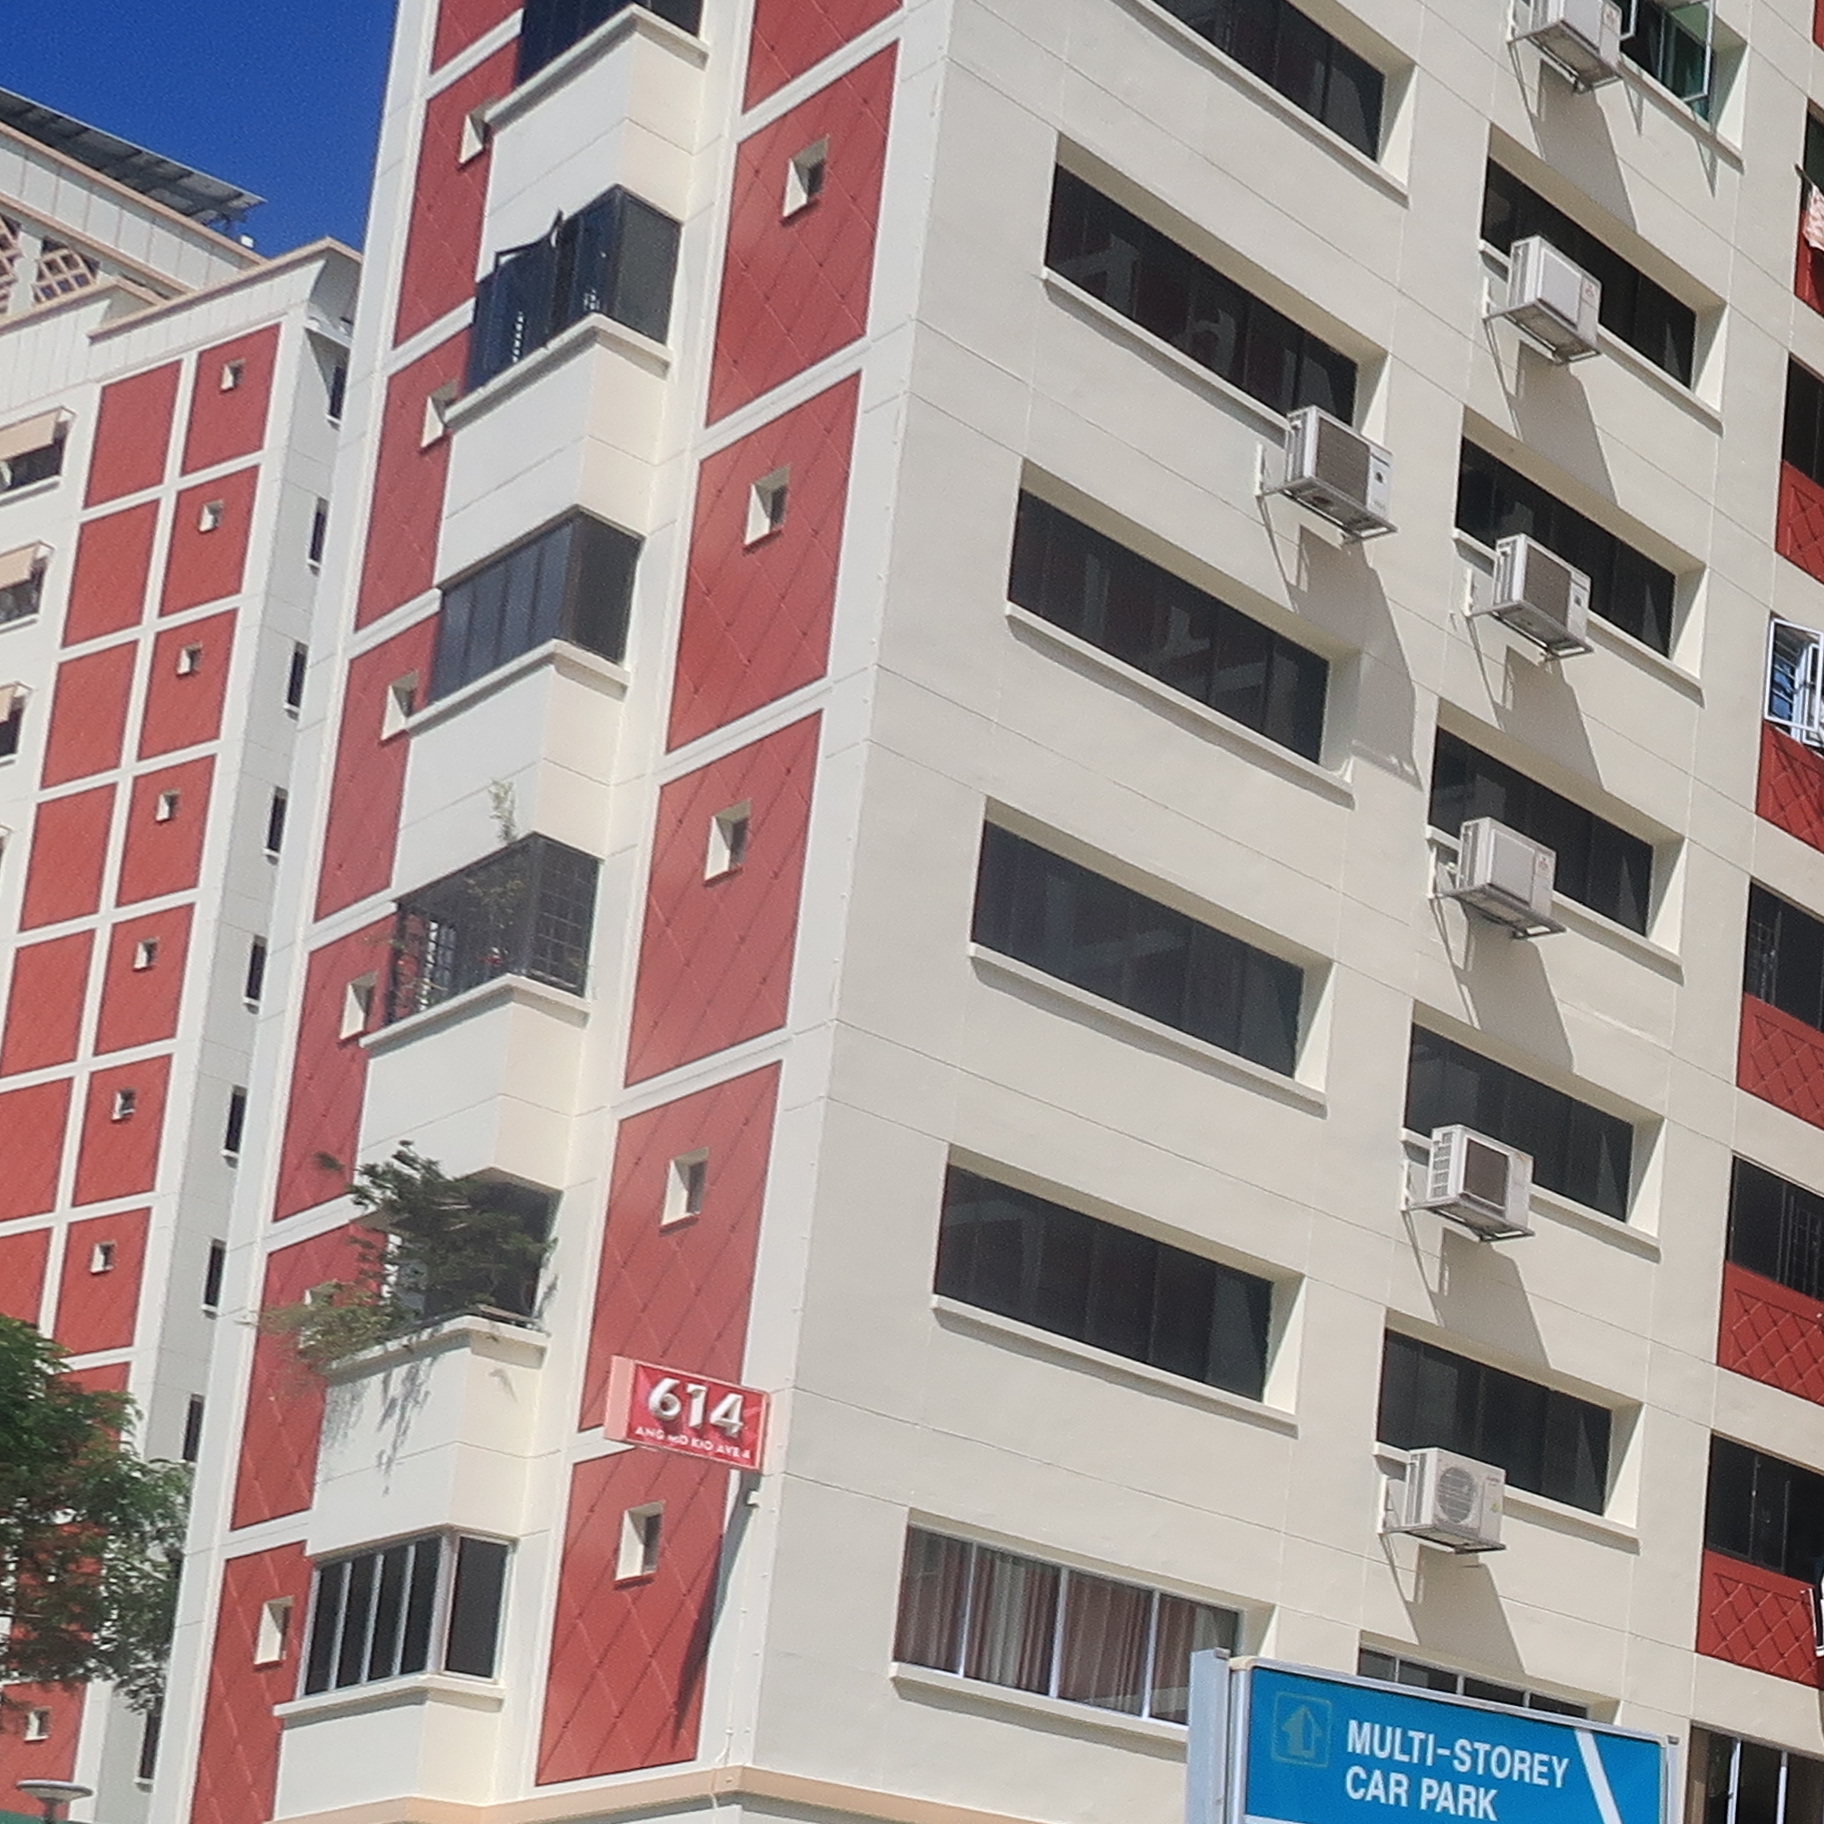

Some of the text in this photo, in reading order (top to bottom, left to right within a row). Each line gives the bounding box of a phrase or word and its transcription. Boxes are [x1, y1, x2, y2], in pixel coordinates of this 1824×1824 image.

[648, 1377, 745, 1438] 614
[634, 1426, 665, 1441] ANG
[667, 1434, 689, 1446] MO
[691, 1437, 714, 1451] KIO
[1347, 1718, 1570, 1789] MULTI-STOREY
[1345, 1765, 1498, 1822] CAR PARK
